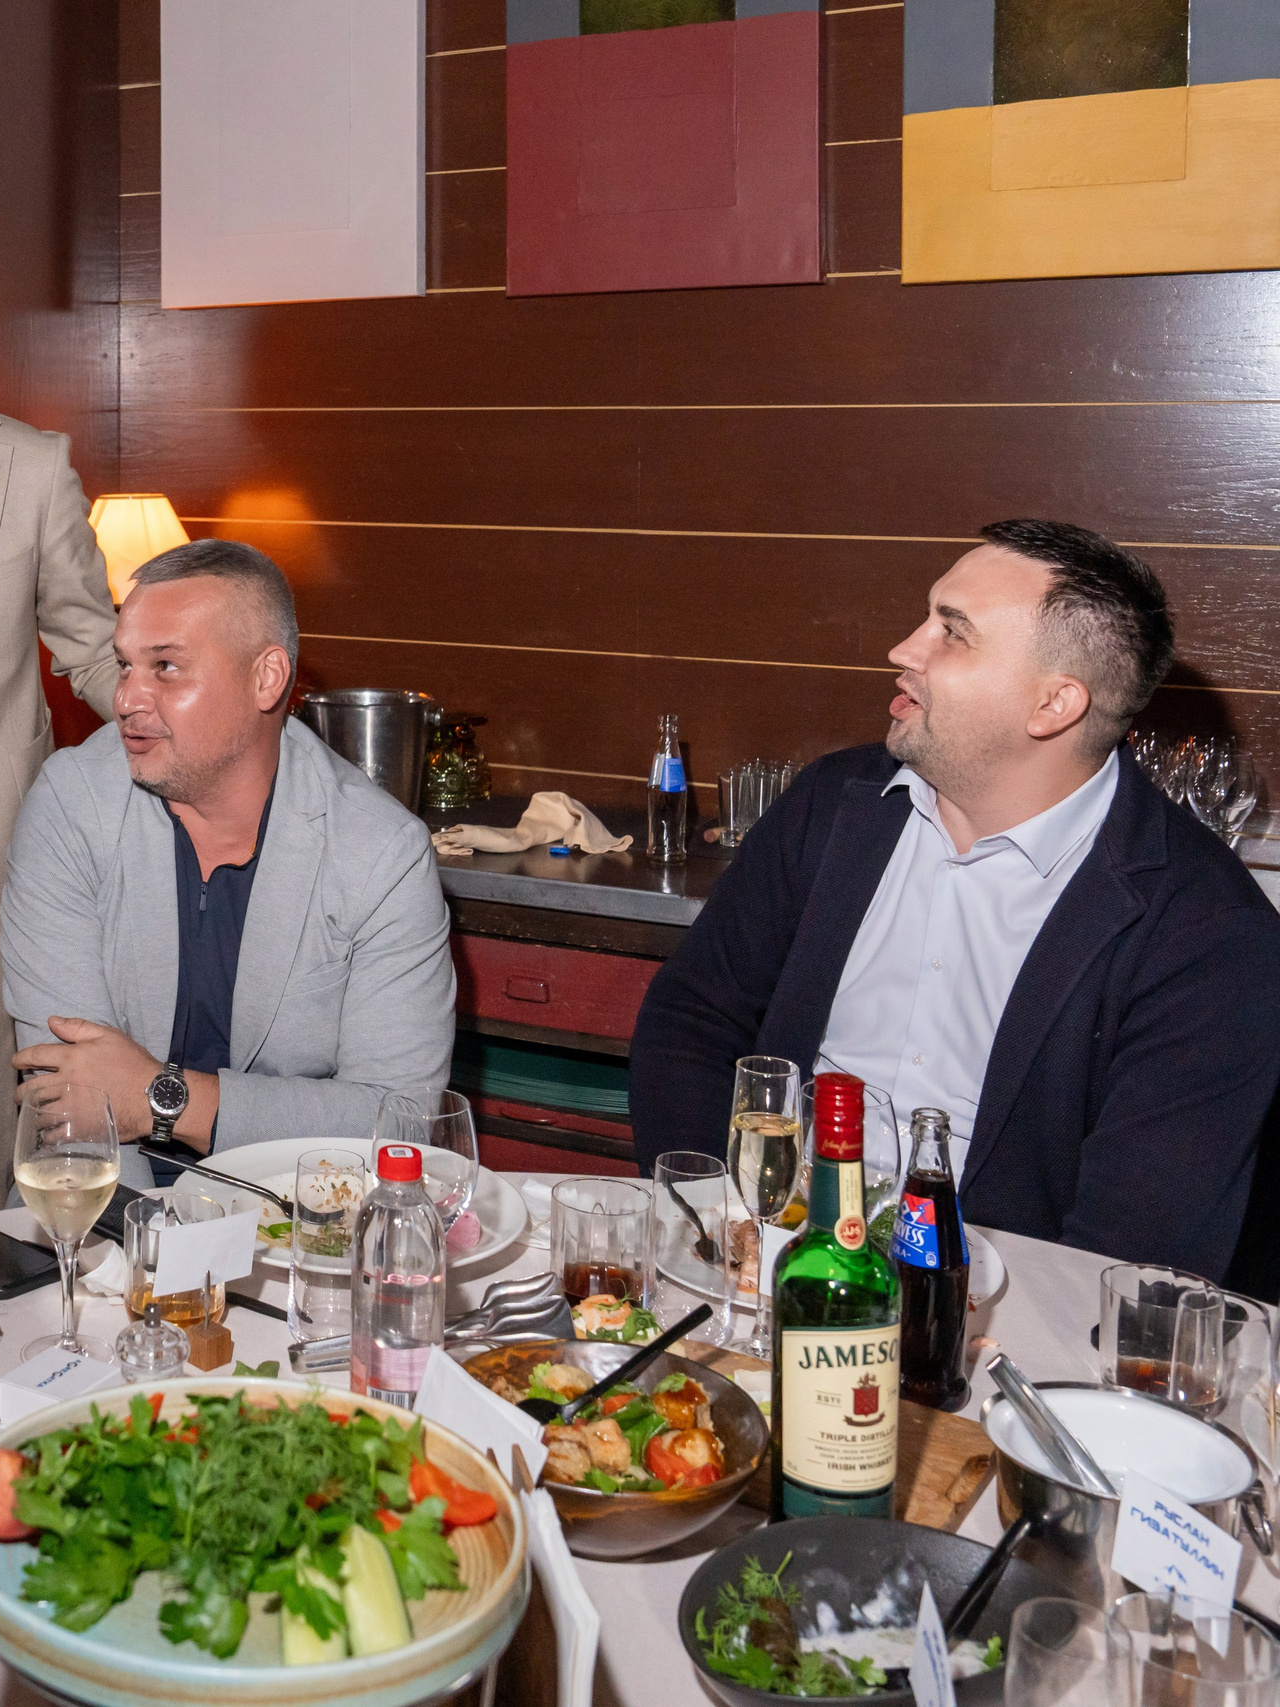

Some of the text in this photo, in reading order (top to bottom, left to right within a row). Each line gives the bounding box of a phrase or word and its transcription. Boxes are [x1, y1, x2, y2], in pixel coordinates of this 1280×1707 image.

[820, 1431, 857, 1443] TRIPLE
[827, 1461, 856, 1471] IRISH
[1154, 1500, 1210, 1547] РУСЛАН
